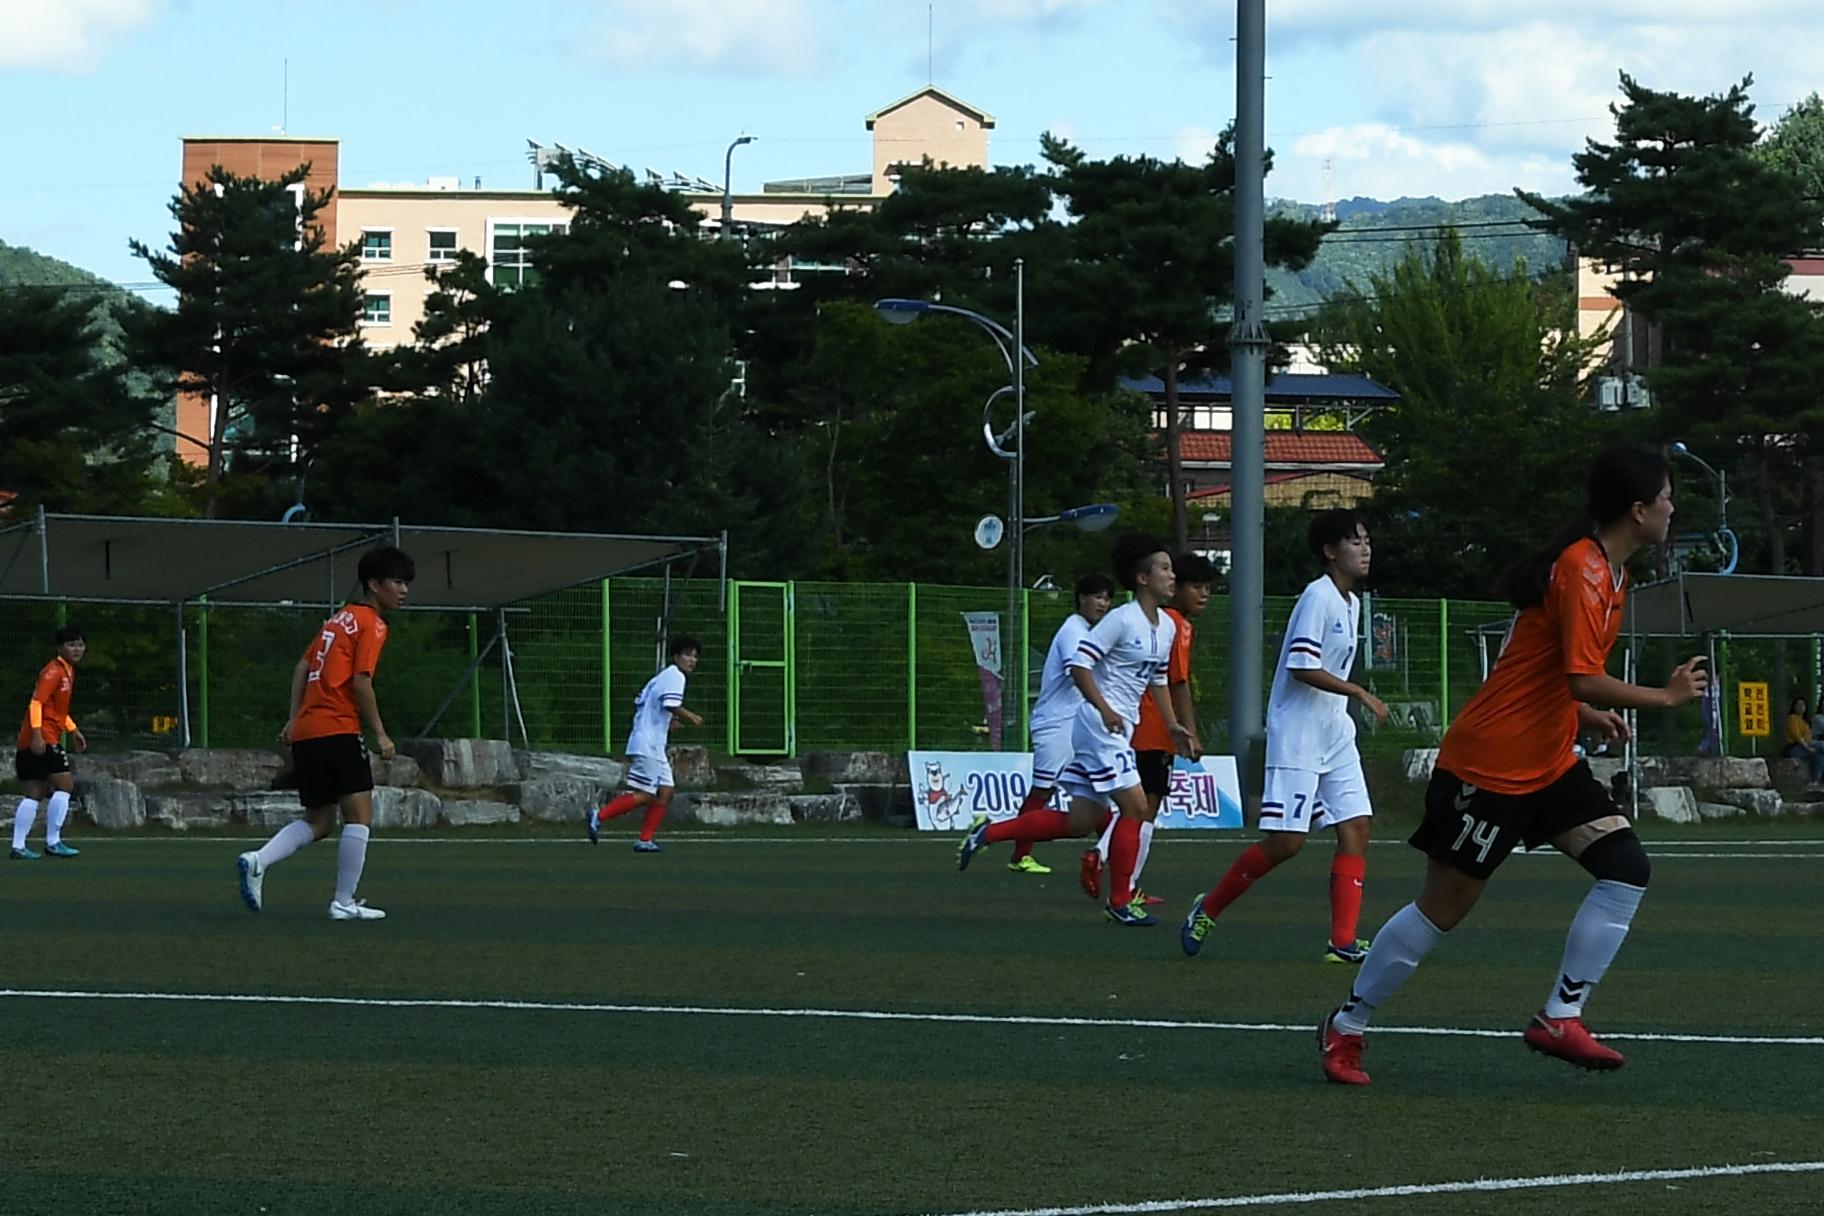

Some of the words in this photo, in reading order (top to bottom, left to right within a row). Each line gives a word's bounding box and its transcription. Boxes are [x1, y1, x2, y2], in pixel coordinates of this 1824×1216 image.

[967, 772, 1026, 812] 2019
[1164, 773, 1217, 815] 축제
[1293, 793, 1306, 818] 7
[1451, 813, 1501, 863] 14
